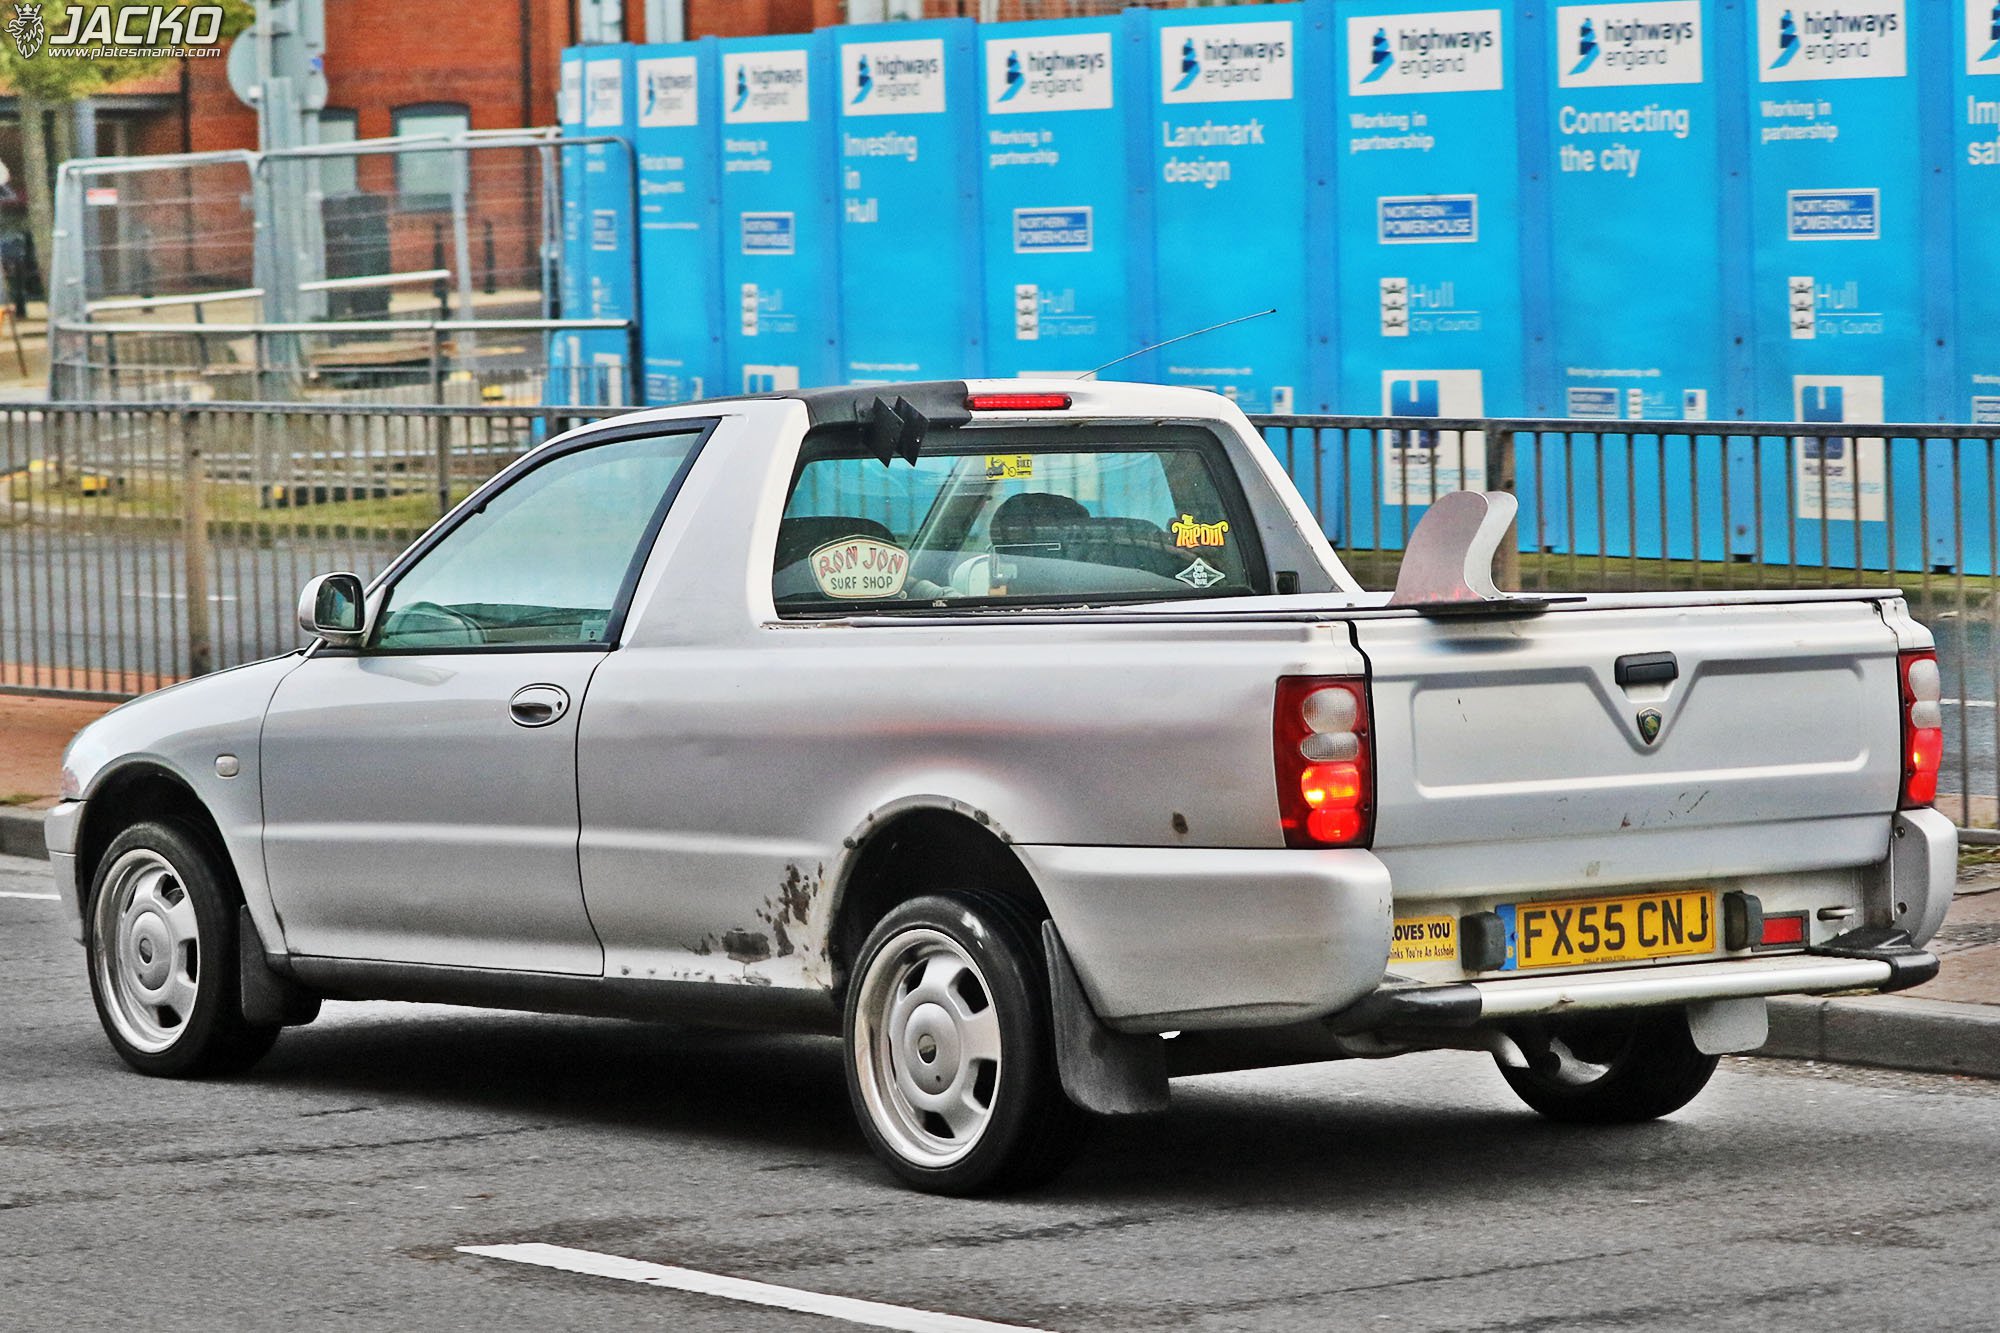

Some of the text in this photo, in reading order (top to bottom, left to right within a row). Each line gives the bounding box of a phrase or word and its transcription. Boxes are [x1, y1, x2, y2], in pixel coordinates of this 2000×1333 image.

[1605, 18, 1694, 46] highways
[1804, 10, 1898, 39] highways
[1204, 37, 1286, 65] highways
[1400, 28, 1493, 56] highways
[1804, 38, 1870, 65] england
[876, 55, 938, 80] highways
[1028, 50, 1105, 76] highways
[1400, 54, 1466, 78] england
[1606, 47, 1667, 71] england
[1029, 76, 1083, 98] england
[1205, 65, 1261, 88] england
[1350, 109, 1428, 131] Working in
[1559, 103, 1691, 139] Connecting
[1760, 98, 1832, 120] Working in
[1967, 95, 2000, 133] Im
[1163, 118, 1265, 148] Landmark
[1350, 131, 1436, 154] partnership
[1760, 121, 1839, 144] partnership
[843, 130, 918, 163] Investing
[1163, 155, 1231, 189] design
[1560, 142, 1641, 178] the city
[844, 165, 861, 190] in
[844, 197, 879, 223] Hull
[1039, 287, 1075, 313] Hull
[1410, 280, 1454, 308] Hull
[1815, 279, 1859, 309] Hull
[819, 545, 905, 579] RON JON
[831, 575, 893, 590] SURF SHOP
[1427, 922, 1450, 939] YOU
[1523, 896, 1709, 958] FX55 CNJ
[1389, 943, 1454, 959] inks You're An Asshole
